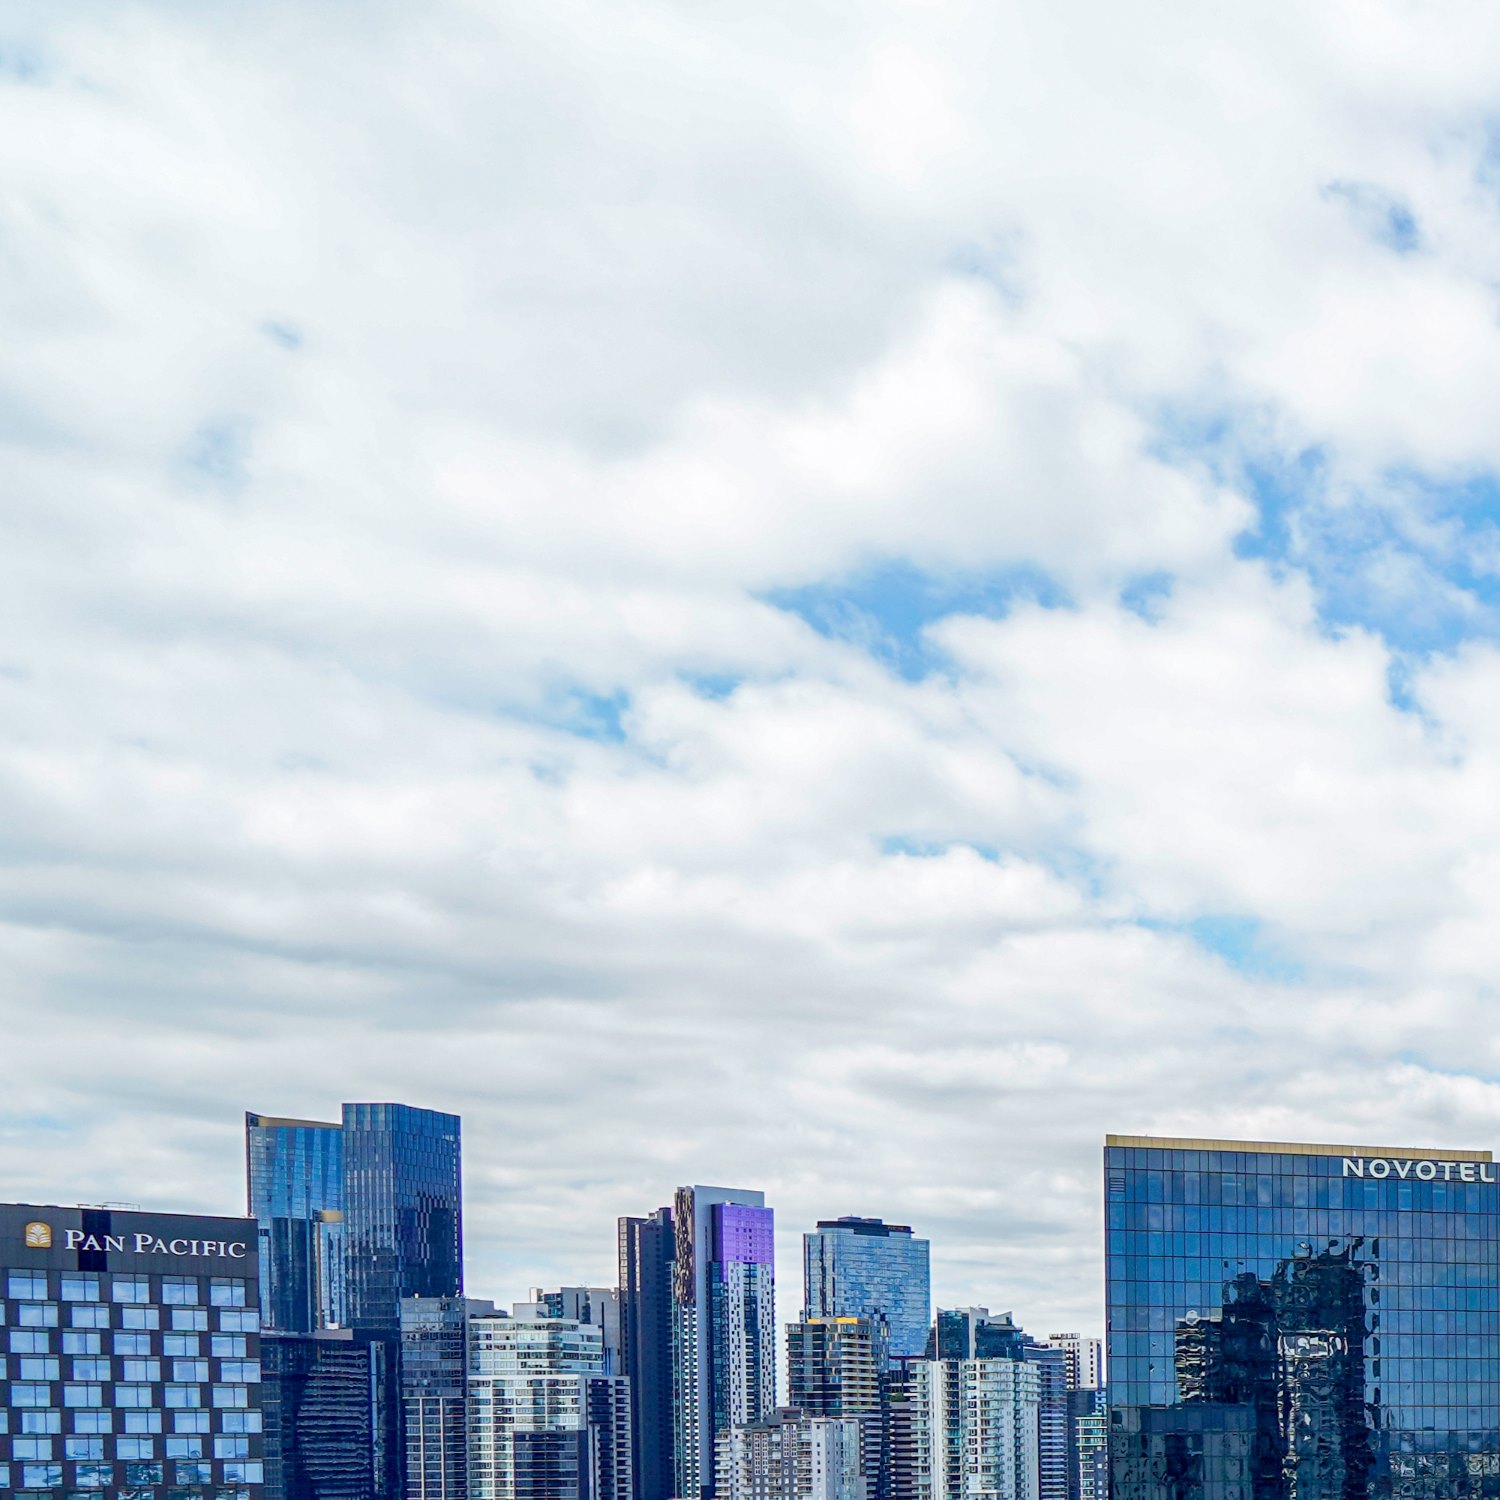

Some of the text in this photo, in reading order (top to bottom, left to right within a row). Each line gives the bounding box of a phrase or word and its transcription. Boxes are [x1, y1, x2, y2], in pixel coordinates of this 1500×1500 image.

[1342, 1157, 1495, 1183] NOVOTEL
[64, 1228, 247, 1259] PAN PACIFIC
